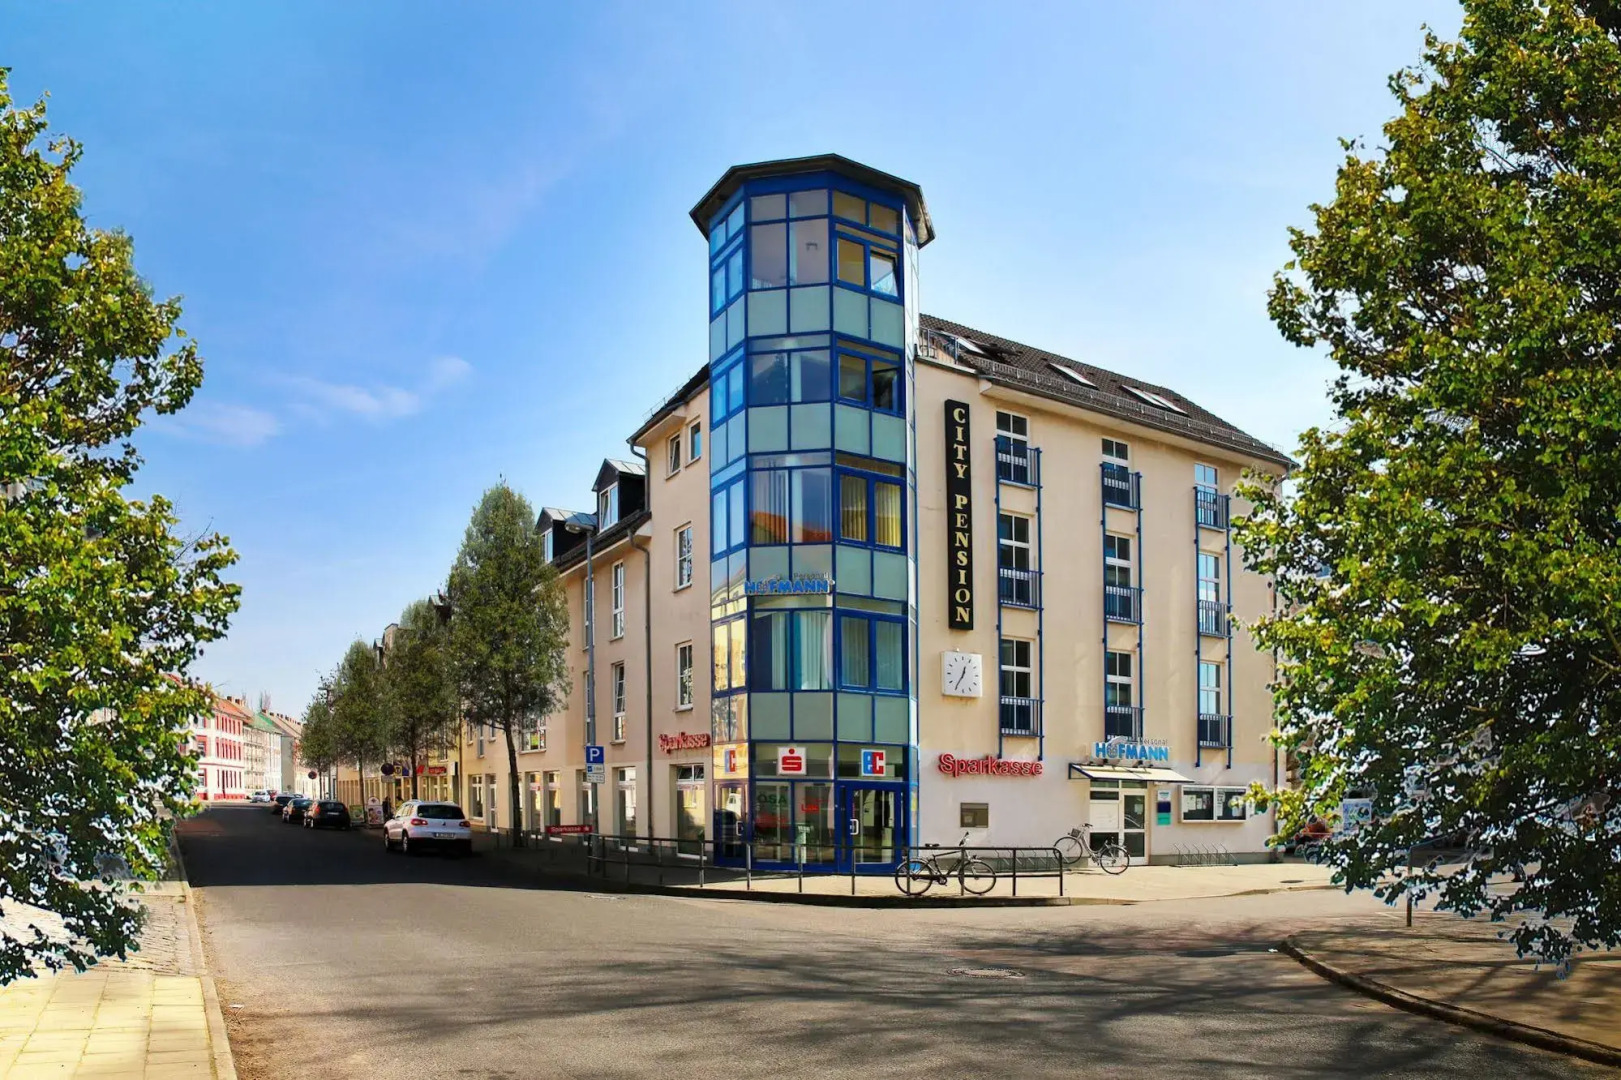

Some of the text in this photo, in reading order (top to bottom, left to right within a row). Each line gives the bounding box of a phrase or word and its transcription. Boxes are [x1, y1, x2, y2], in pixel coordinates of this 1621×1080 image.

[953, 408, 971, 624] CITY PENSION
[659, 732, 711, 754] Sparkasse
[1095, 741, 1169, 761] HOFMANN
[589, 748, 600, 762] P
[938, 753, 1043, 777] Sparkasse
